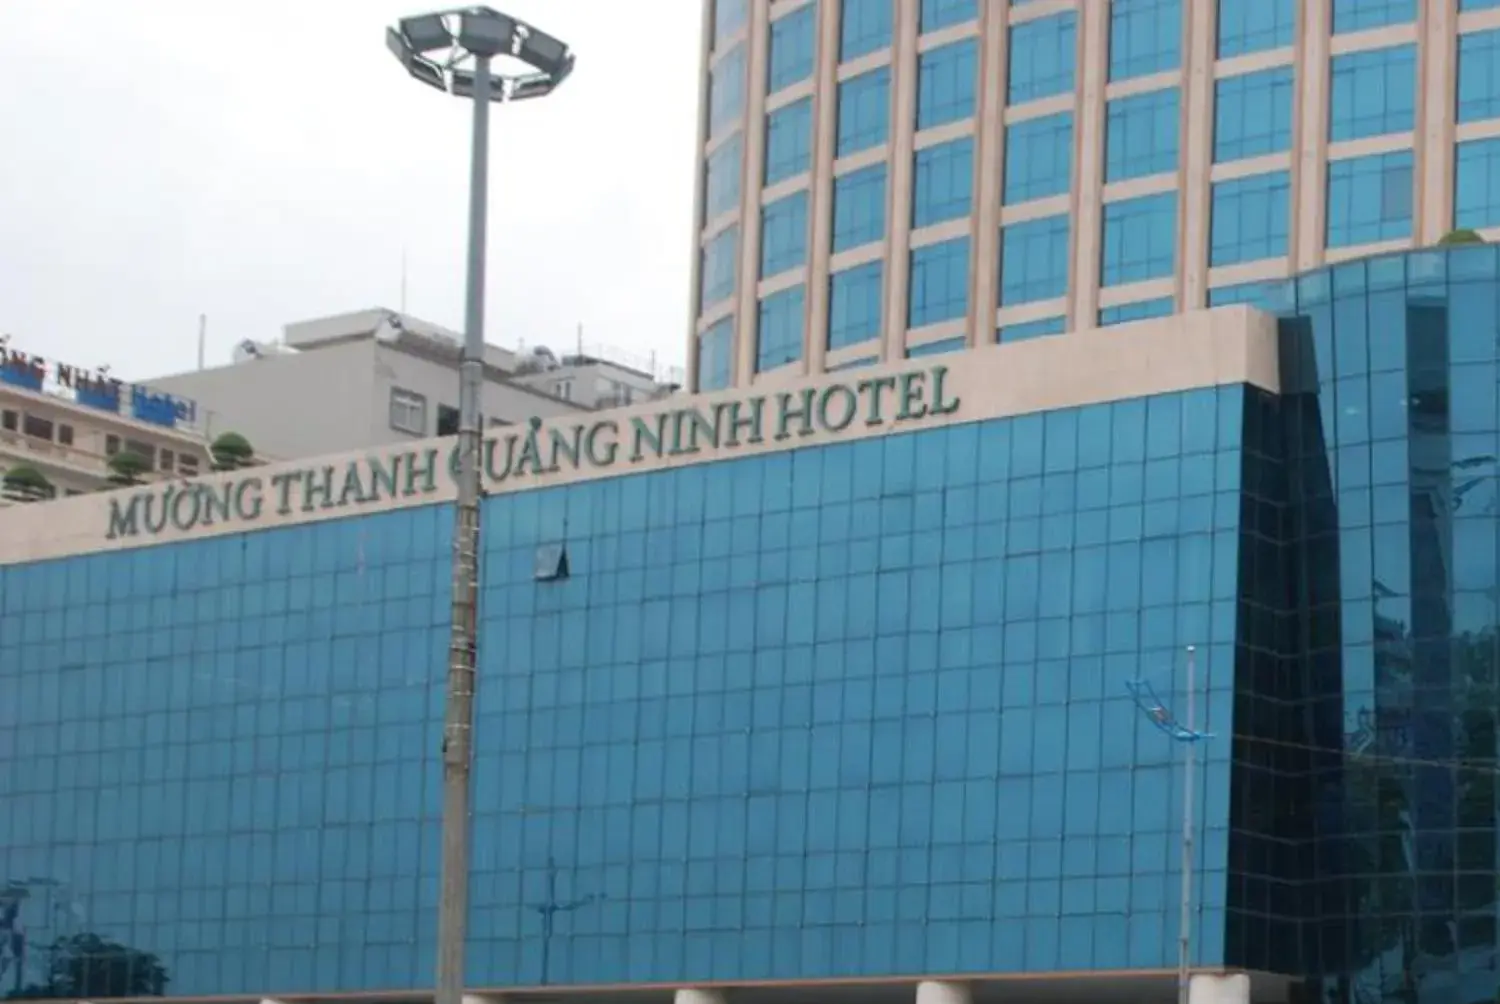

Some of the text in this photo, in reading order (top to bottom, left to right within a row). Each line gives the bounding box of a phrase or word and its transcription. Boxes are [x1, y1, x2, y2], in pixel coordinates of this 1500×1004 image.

[106, 477, 262, 539] MƯỜNG
[271, 448, 438, 515] THANH
[629, 396, 766, 462] NINH
[774, 365, 960, 441] HOTEL
